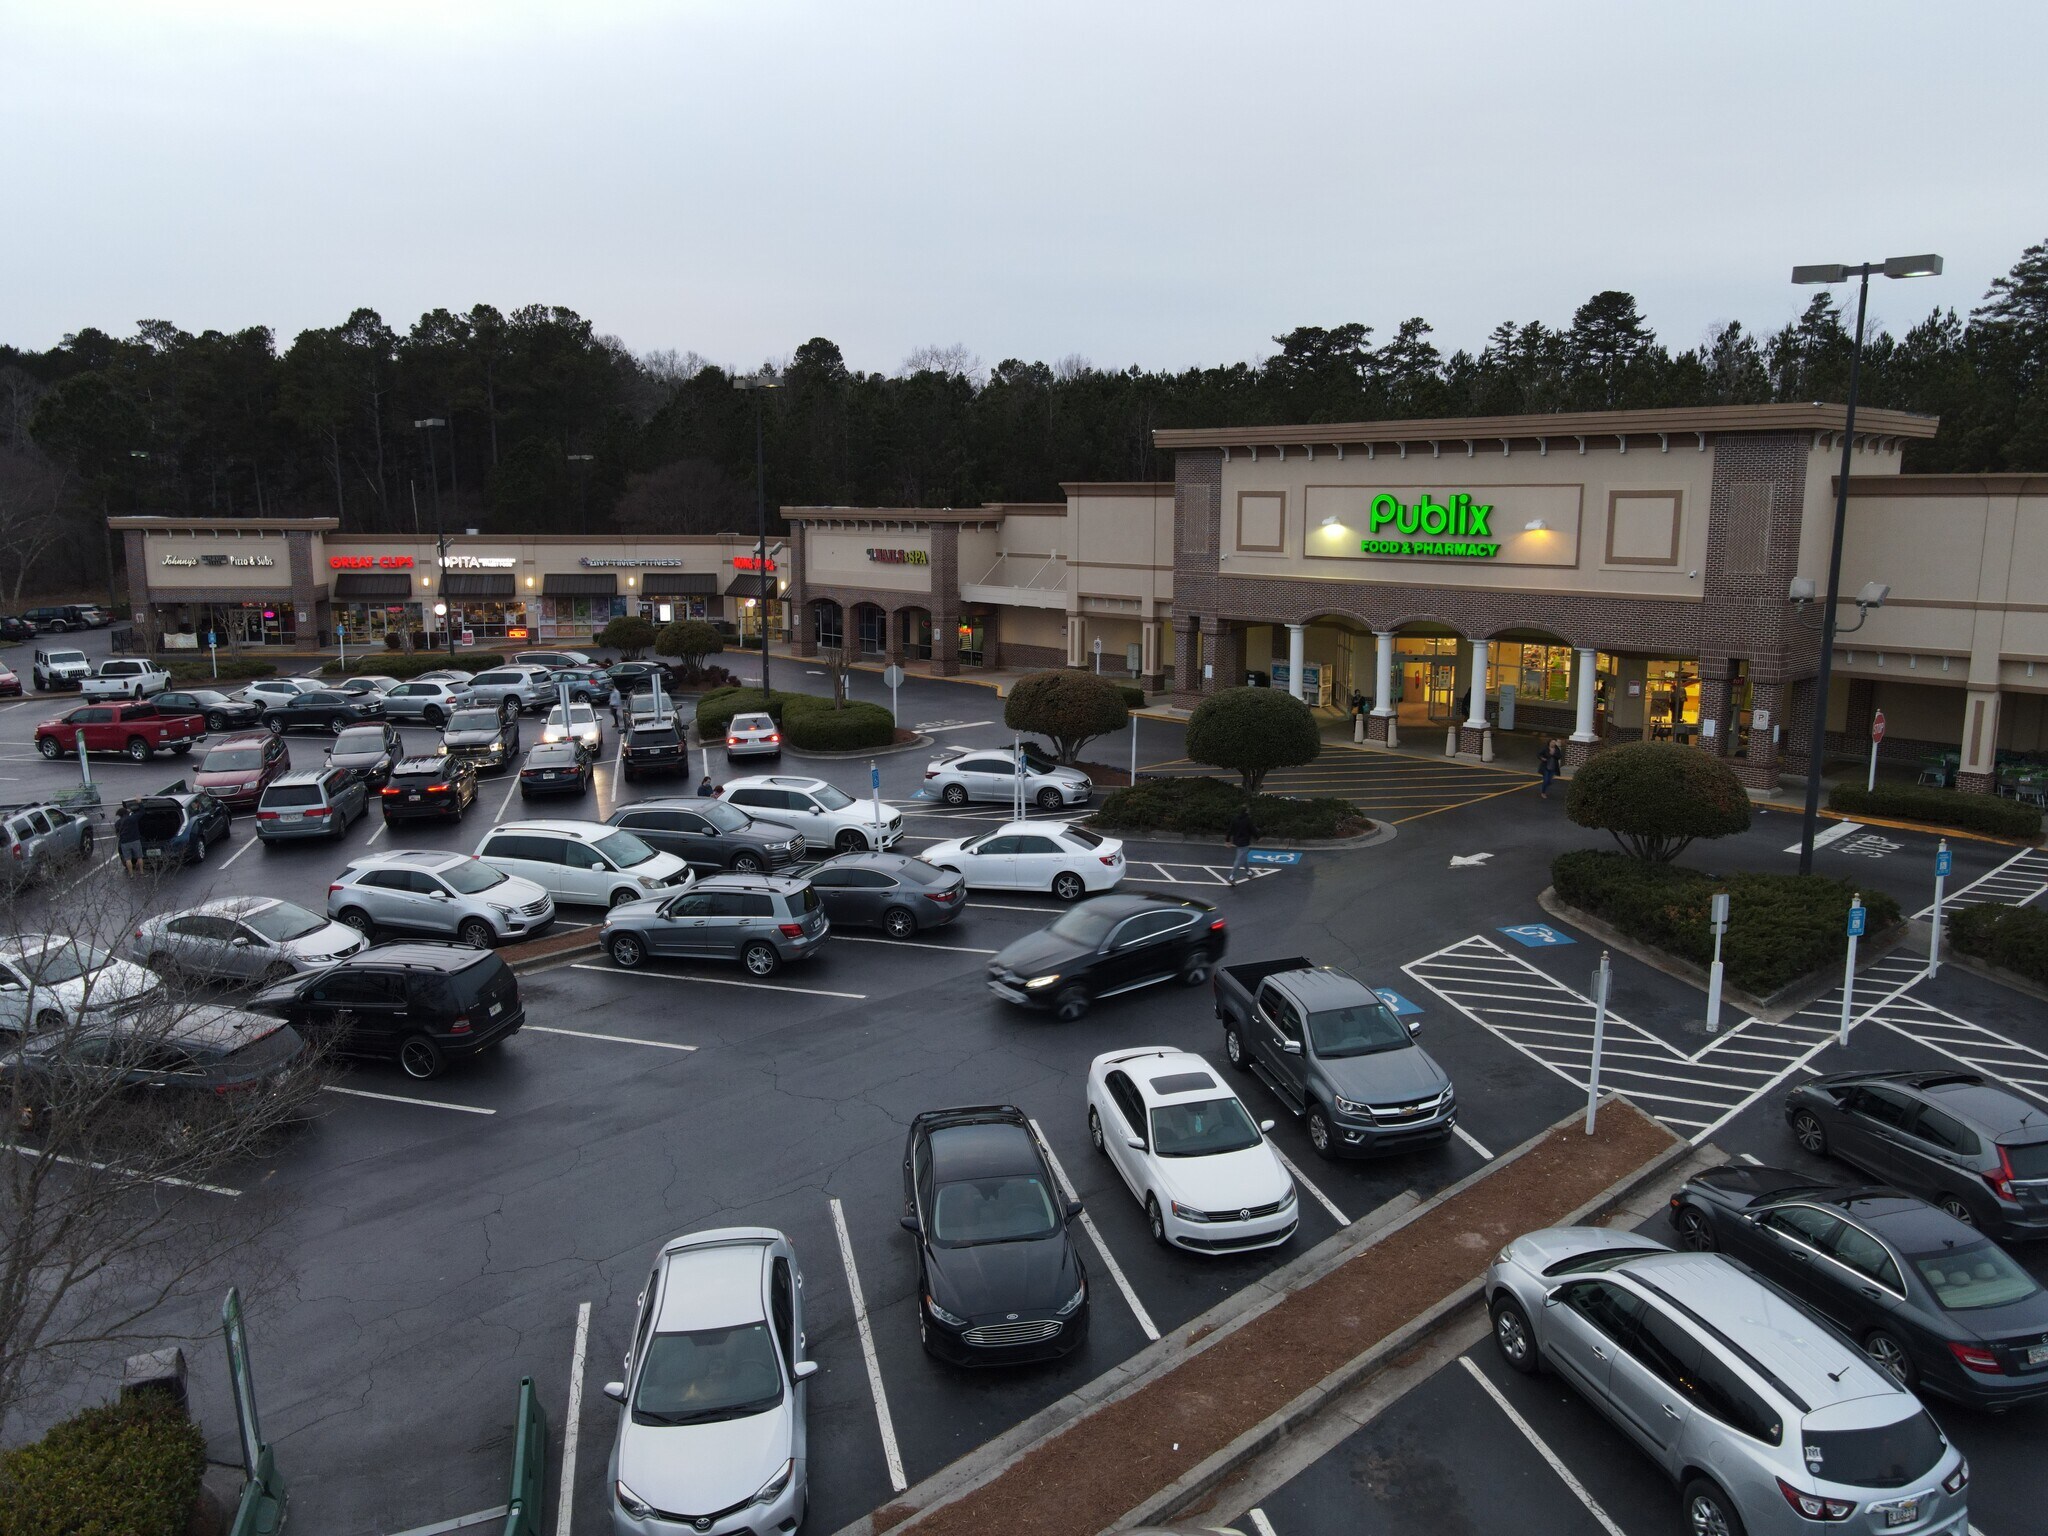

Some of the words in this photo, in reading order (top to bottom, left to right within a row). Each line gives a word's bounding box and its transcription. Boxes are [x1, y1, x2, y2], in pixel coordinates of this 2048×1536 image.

[1370, 493, 1493, 536] Publix
[1361, 540, 1400, 553] FOOD
[1401, 541, 1412, 554] &
[1413, 542, 1501, 557] PHARMACY
[162, 555, 197, 567] Johnny's
[230, 555, 247, 566] Pizza
[249, 556, 255, 566] &
[257, 555, 274, 566] Subs
[331, 556, 374, 569] GREAT
[379, 556, 415, 569] CLIPS
[590, 558, 636, 567] ANYTIME
[639, 558, 682, 567] FITNESS
[910, 550, 928, 564] SPA
